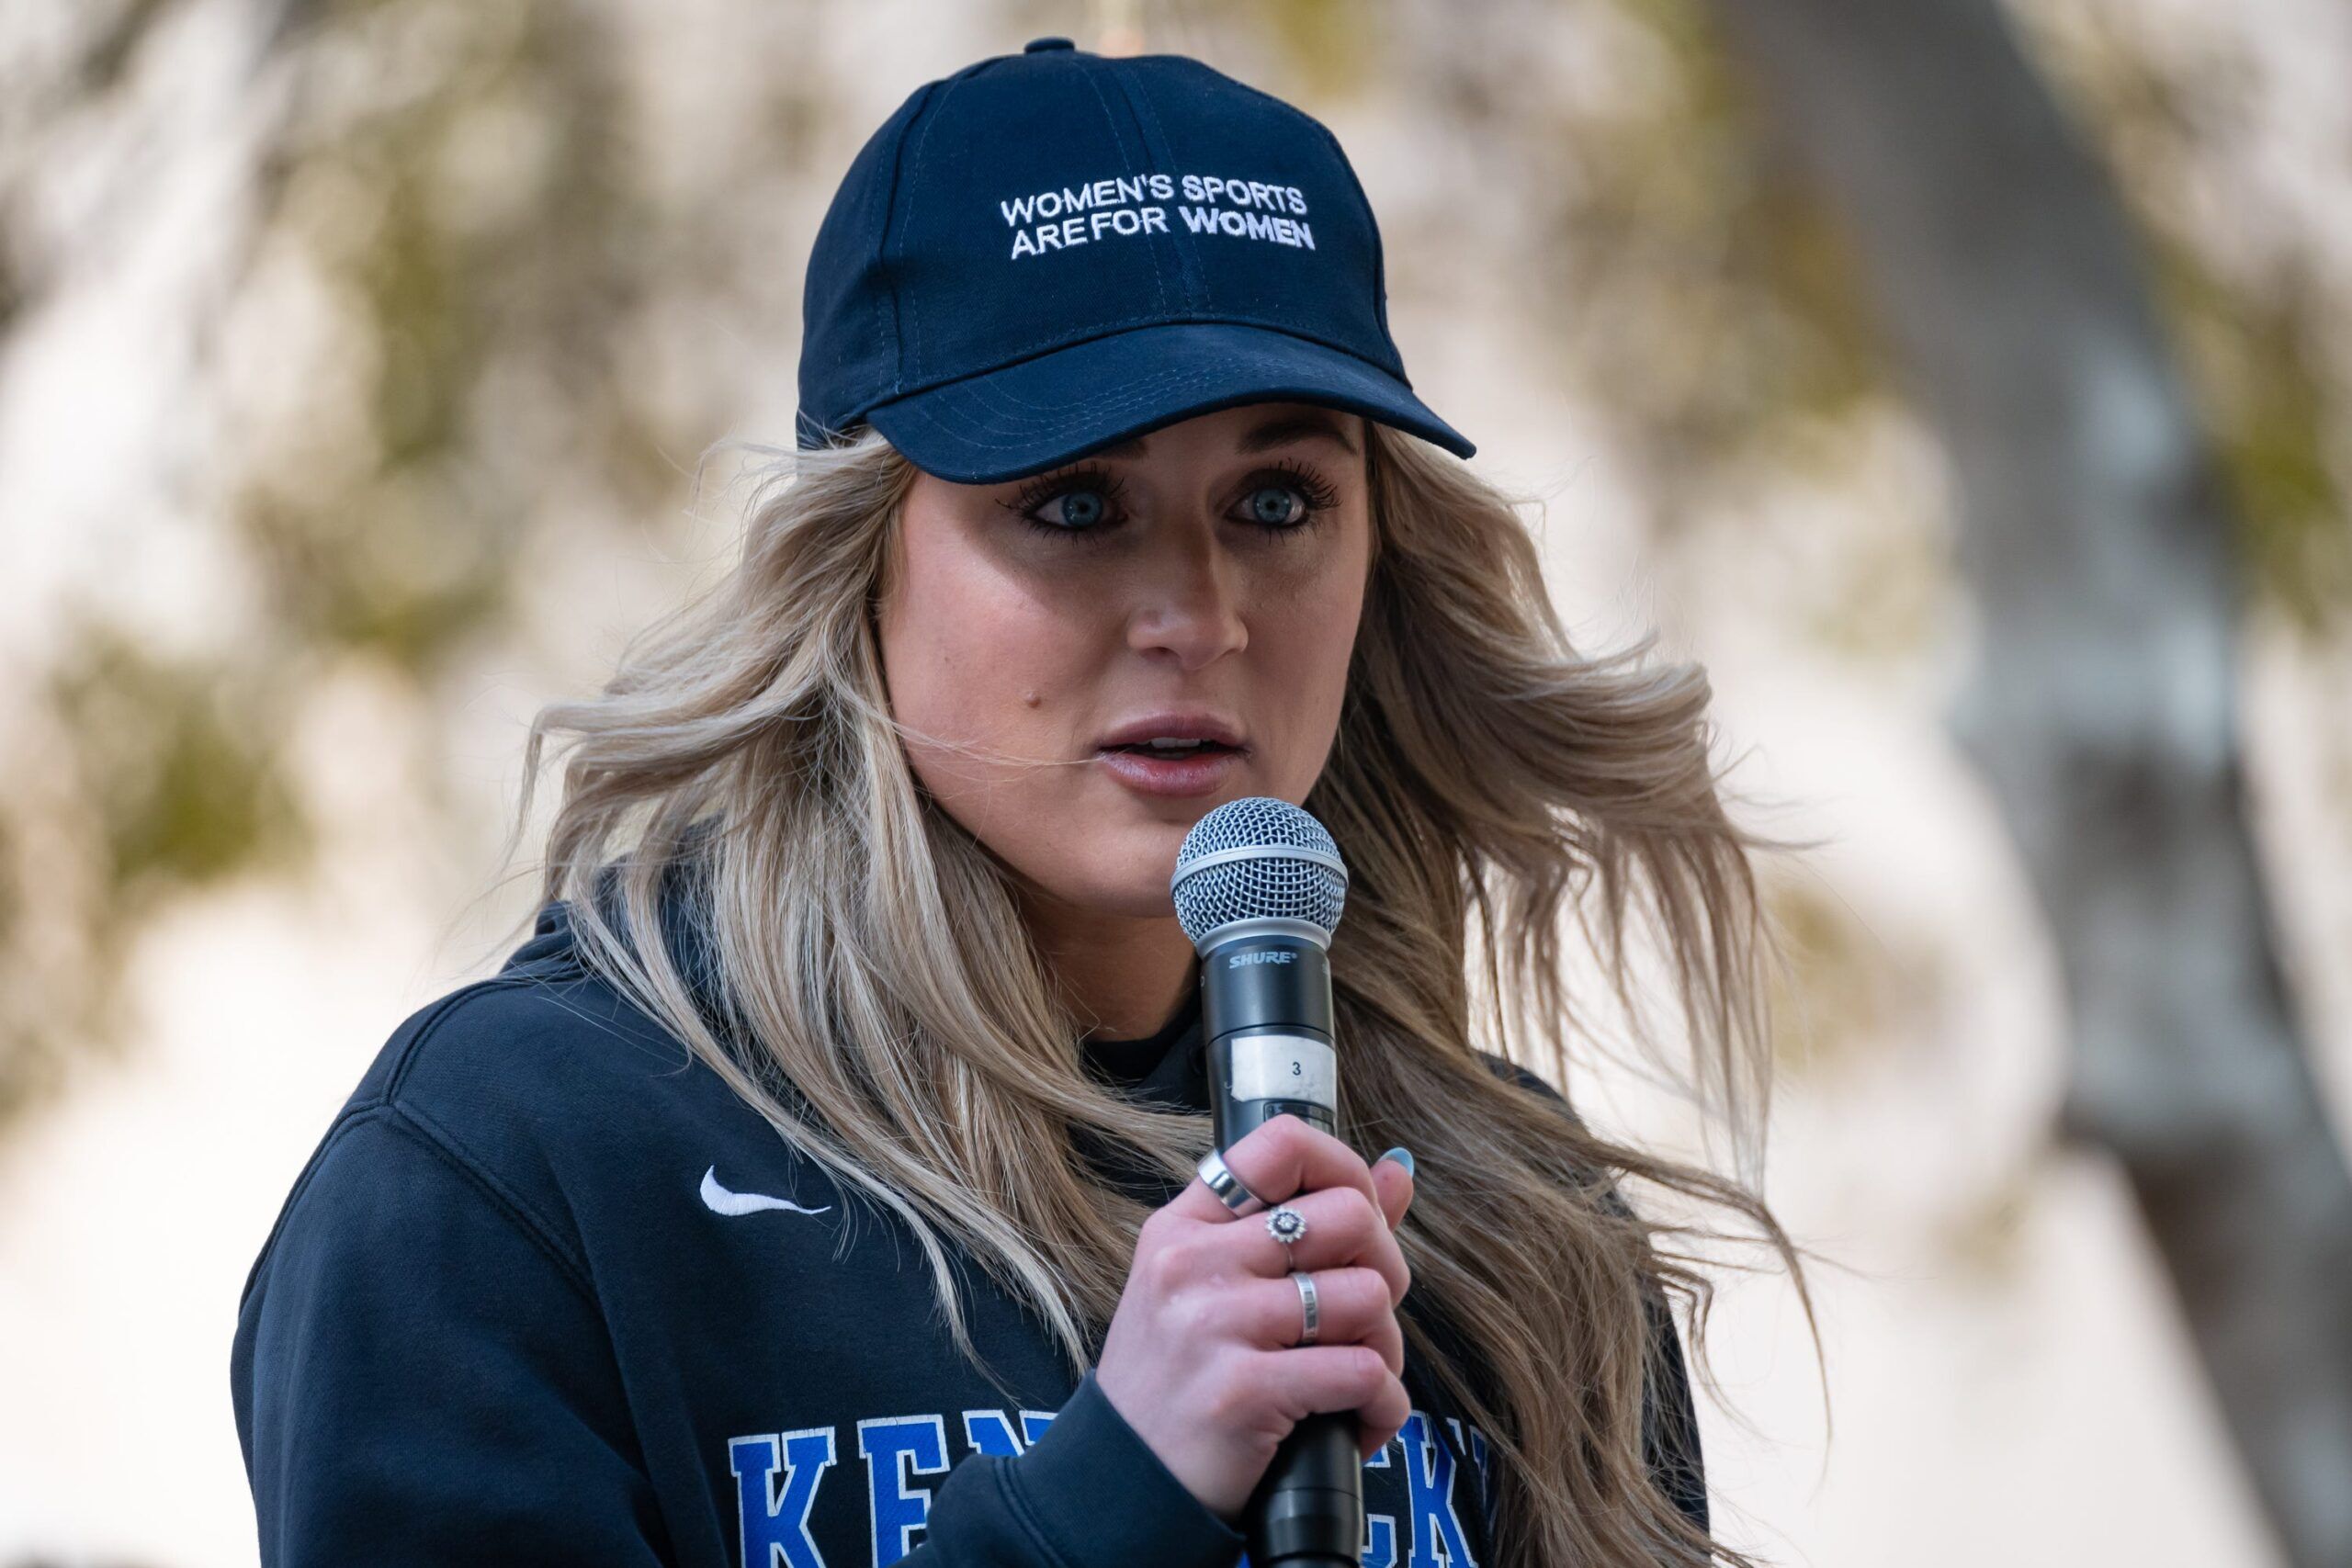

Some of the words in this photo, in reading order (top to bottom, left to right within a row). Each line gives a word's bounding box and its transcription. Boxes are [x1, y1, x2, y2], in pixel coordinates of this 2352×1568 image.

[1001, 175, 1174, 227] WOMEN'S
[1182, 175, 1308, 215] SPORTS
[1011, 217, 1090, 260] ARE
[1091, 207, 1170, 240] FOR
[1180, 206, 1316, 250] WOMEN
[1228, 951, 1292, 969] SHURE
[1292, 1062, 1301, 1076] 3
